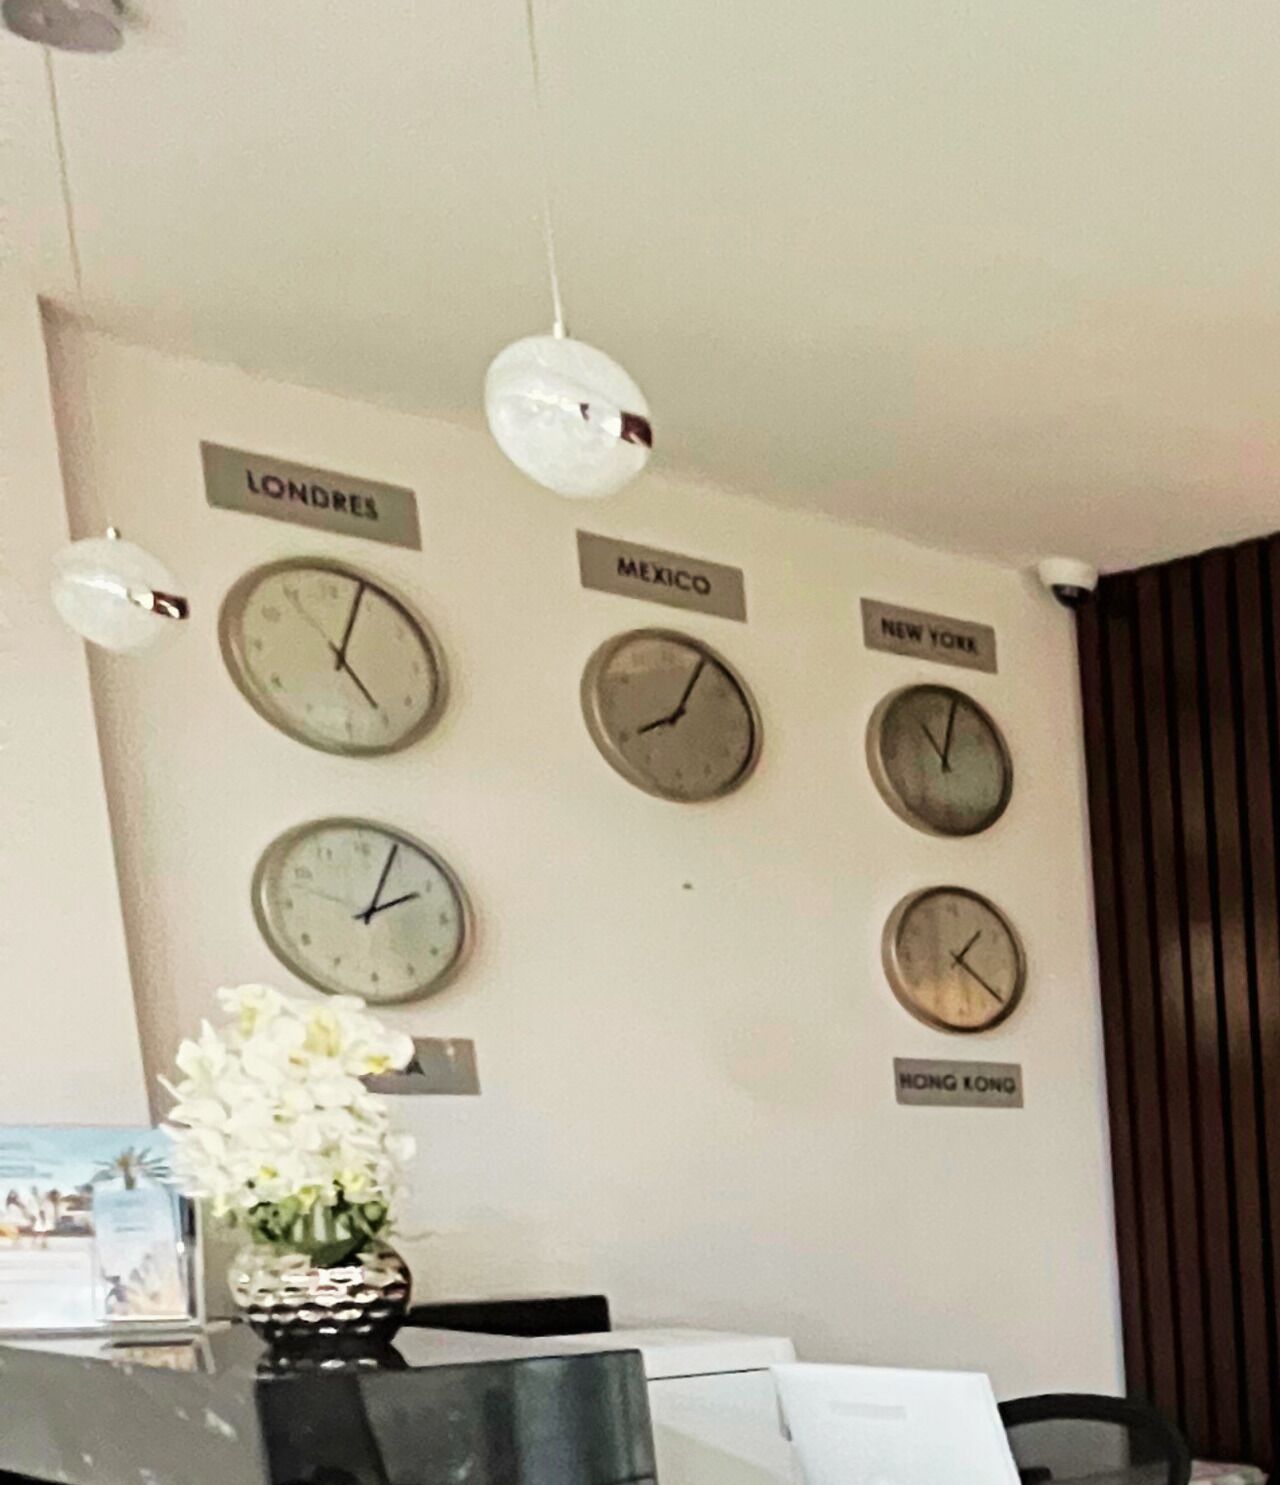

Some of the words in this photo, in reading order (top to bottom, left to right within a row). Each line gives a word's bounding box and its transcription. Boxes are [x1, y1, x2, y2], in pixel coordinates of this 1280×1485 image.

[246, 470, 379, 521] LONDRES
[617, 557, 712, 595] MEXICO
[881, 616, 923, 643] NEW
[928, 625, 979, 655] YORK
[899, 1072, 958, 1092] HONG
[963, 1074, 1016, 1095] KONG
